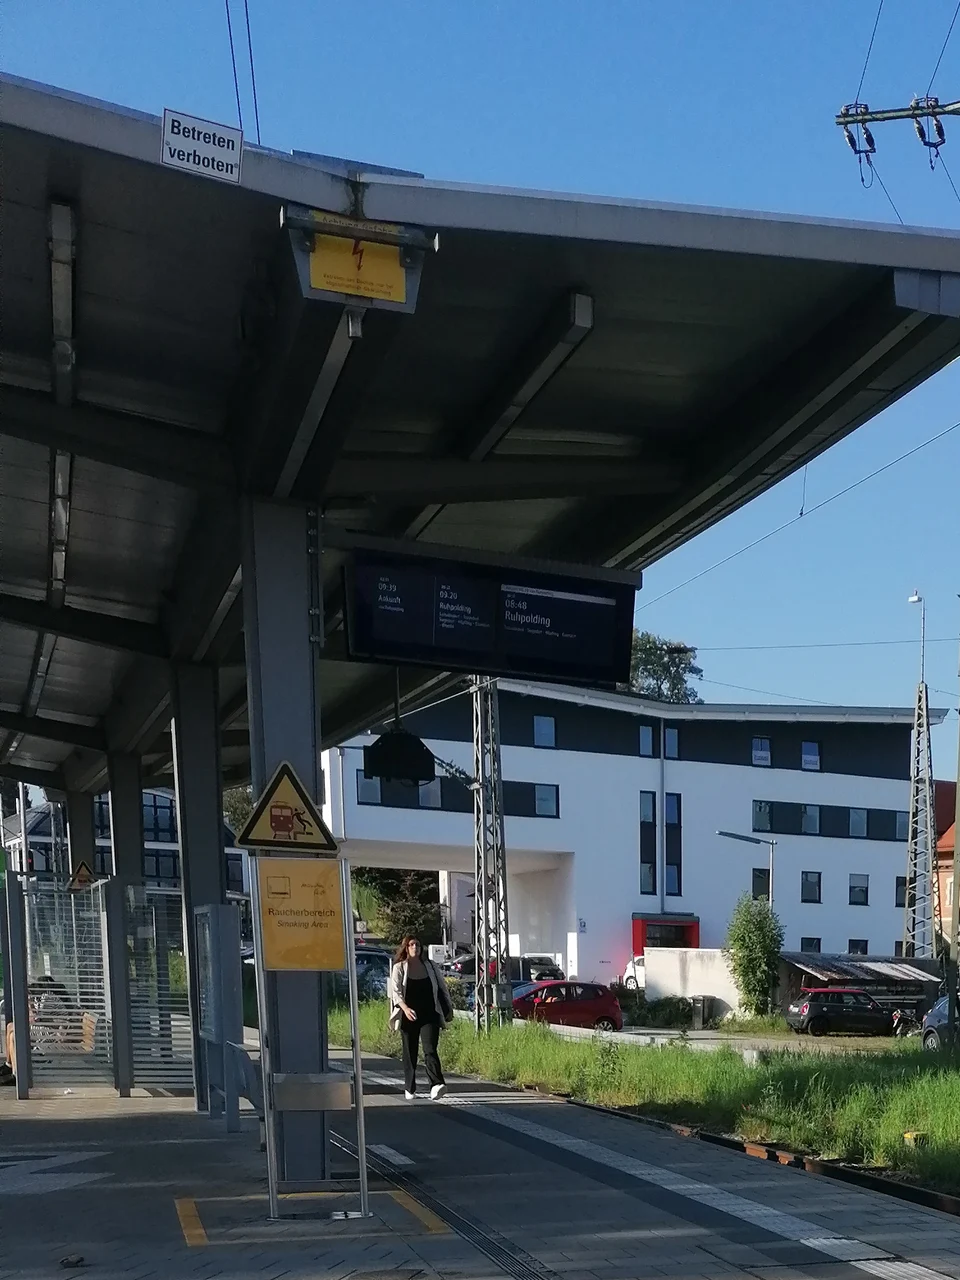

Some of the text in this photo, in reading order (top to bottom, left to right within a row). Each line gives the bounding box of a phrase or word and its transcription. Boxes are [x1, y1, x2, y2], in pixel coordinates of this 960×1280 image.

[170, 118, 235, 151] Betreten
[168, 146, 234, 174] verboten
[439, 601, 472, 615] Ruhpolding
[505, 599, 527, 610] 08:48
[505, 610, 551, 628] Ruhpolding
[268, 907, 336, 917] Raucherbereich
[277, 919, 329, 929] Smoking Area
